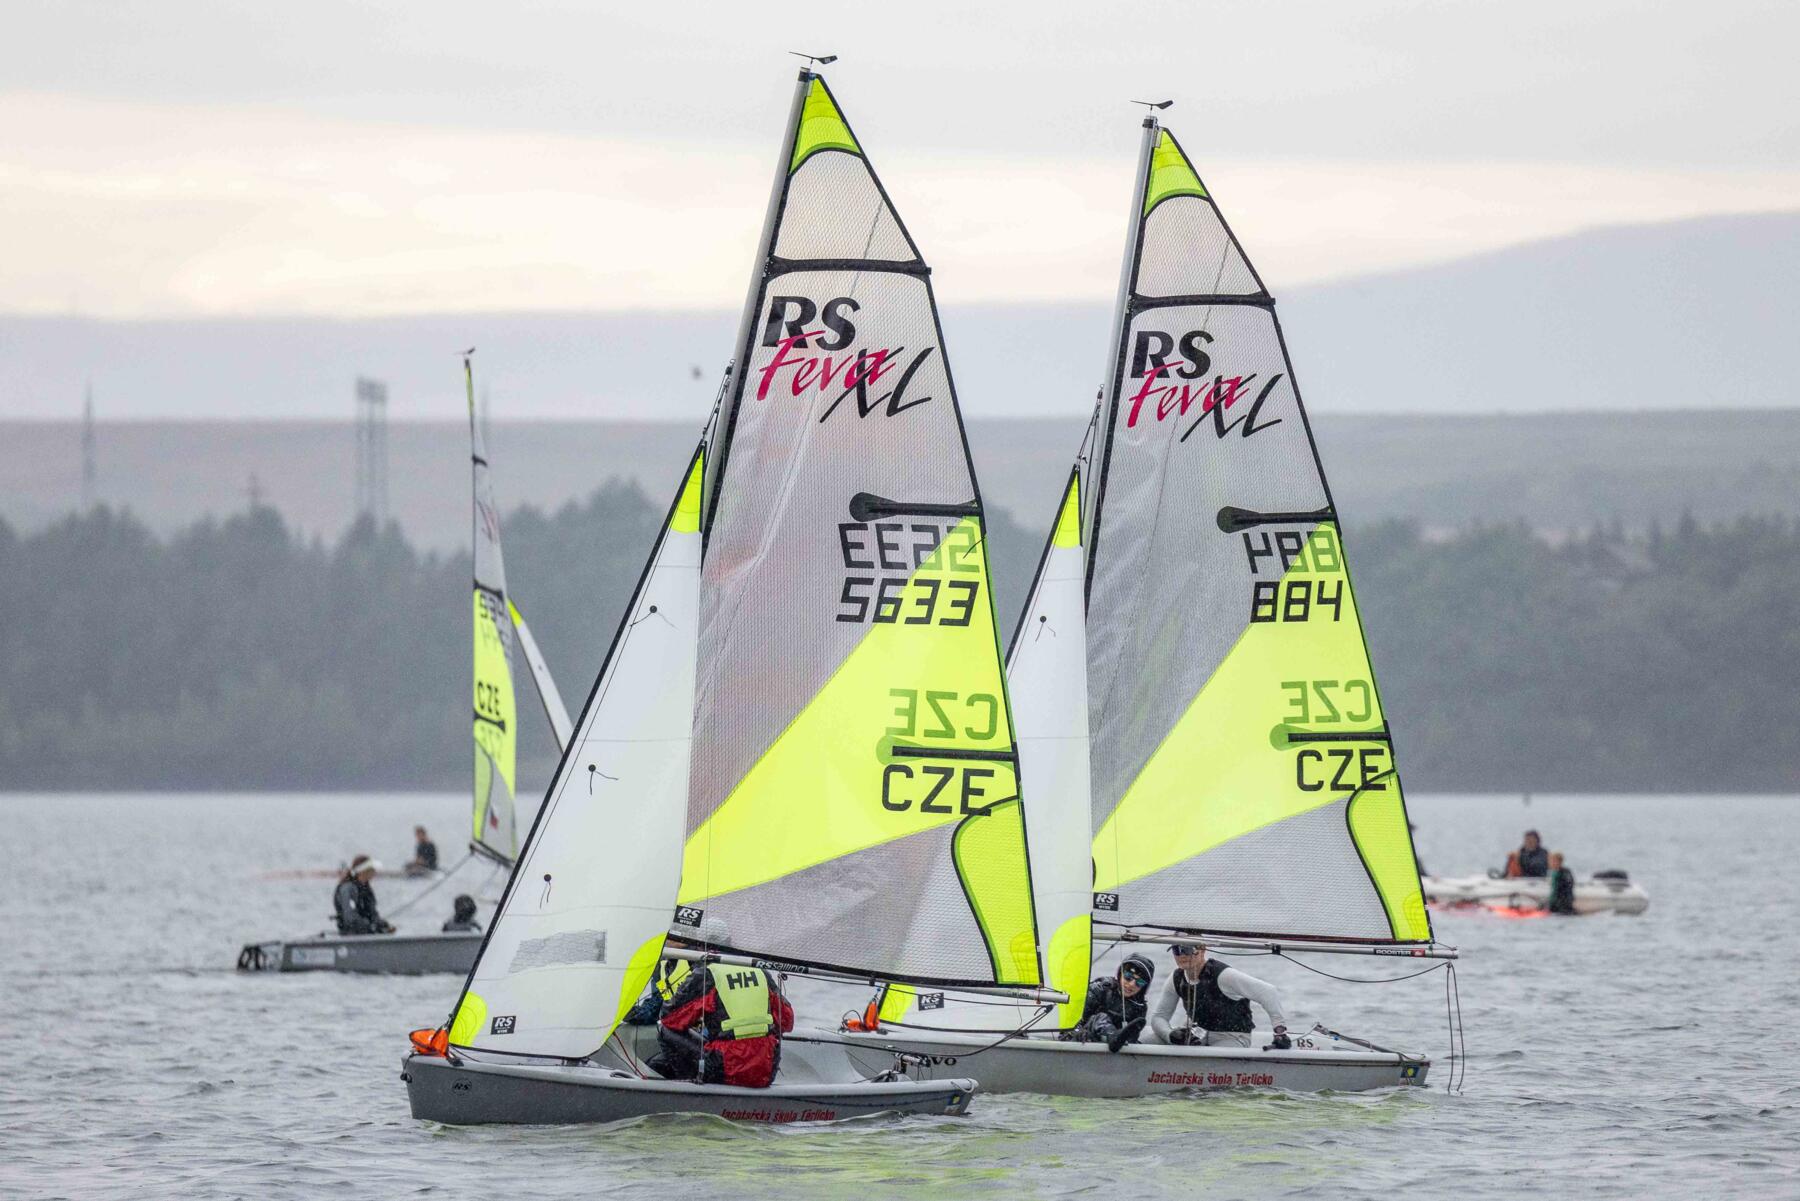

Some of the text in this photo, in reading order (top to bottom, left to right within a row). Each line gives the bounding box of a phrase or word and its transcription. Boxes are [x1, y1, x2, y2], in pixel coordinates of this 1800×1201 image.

[762, 295, 861, 352] RS
[1130, 330, 1215, 380] RS
[756, 330, 935, 424] Feva XL
[1127, 360, 1285, 443] Feva XL
[836, 576, 980, 627] 5633
[1250, 580, 1344, 623] 884
[478, 681, 500, 716] CZE
[881, 764, 995, 817] CZE
[1296, 748, 1387, 792] CZE
[678, 907, 701, 919] RS
[1096, 893, 1116, 904] RS
[726, 970, 759, 990] HH
[494, 1016, 514, 1027] RS
[1296, 1038, 1314, 1049] RS
